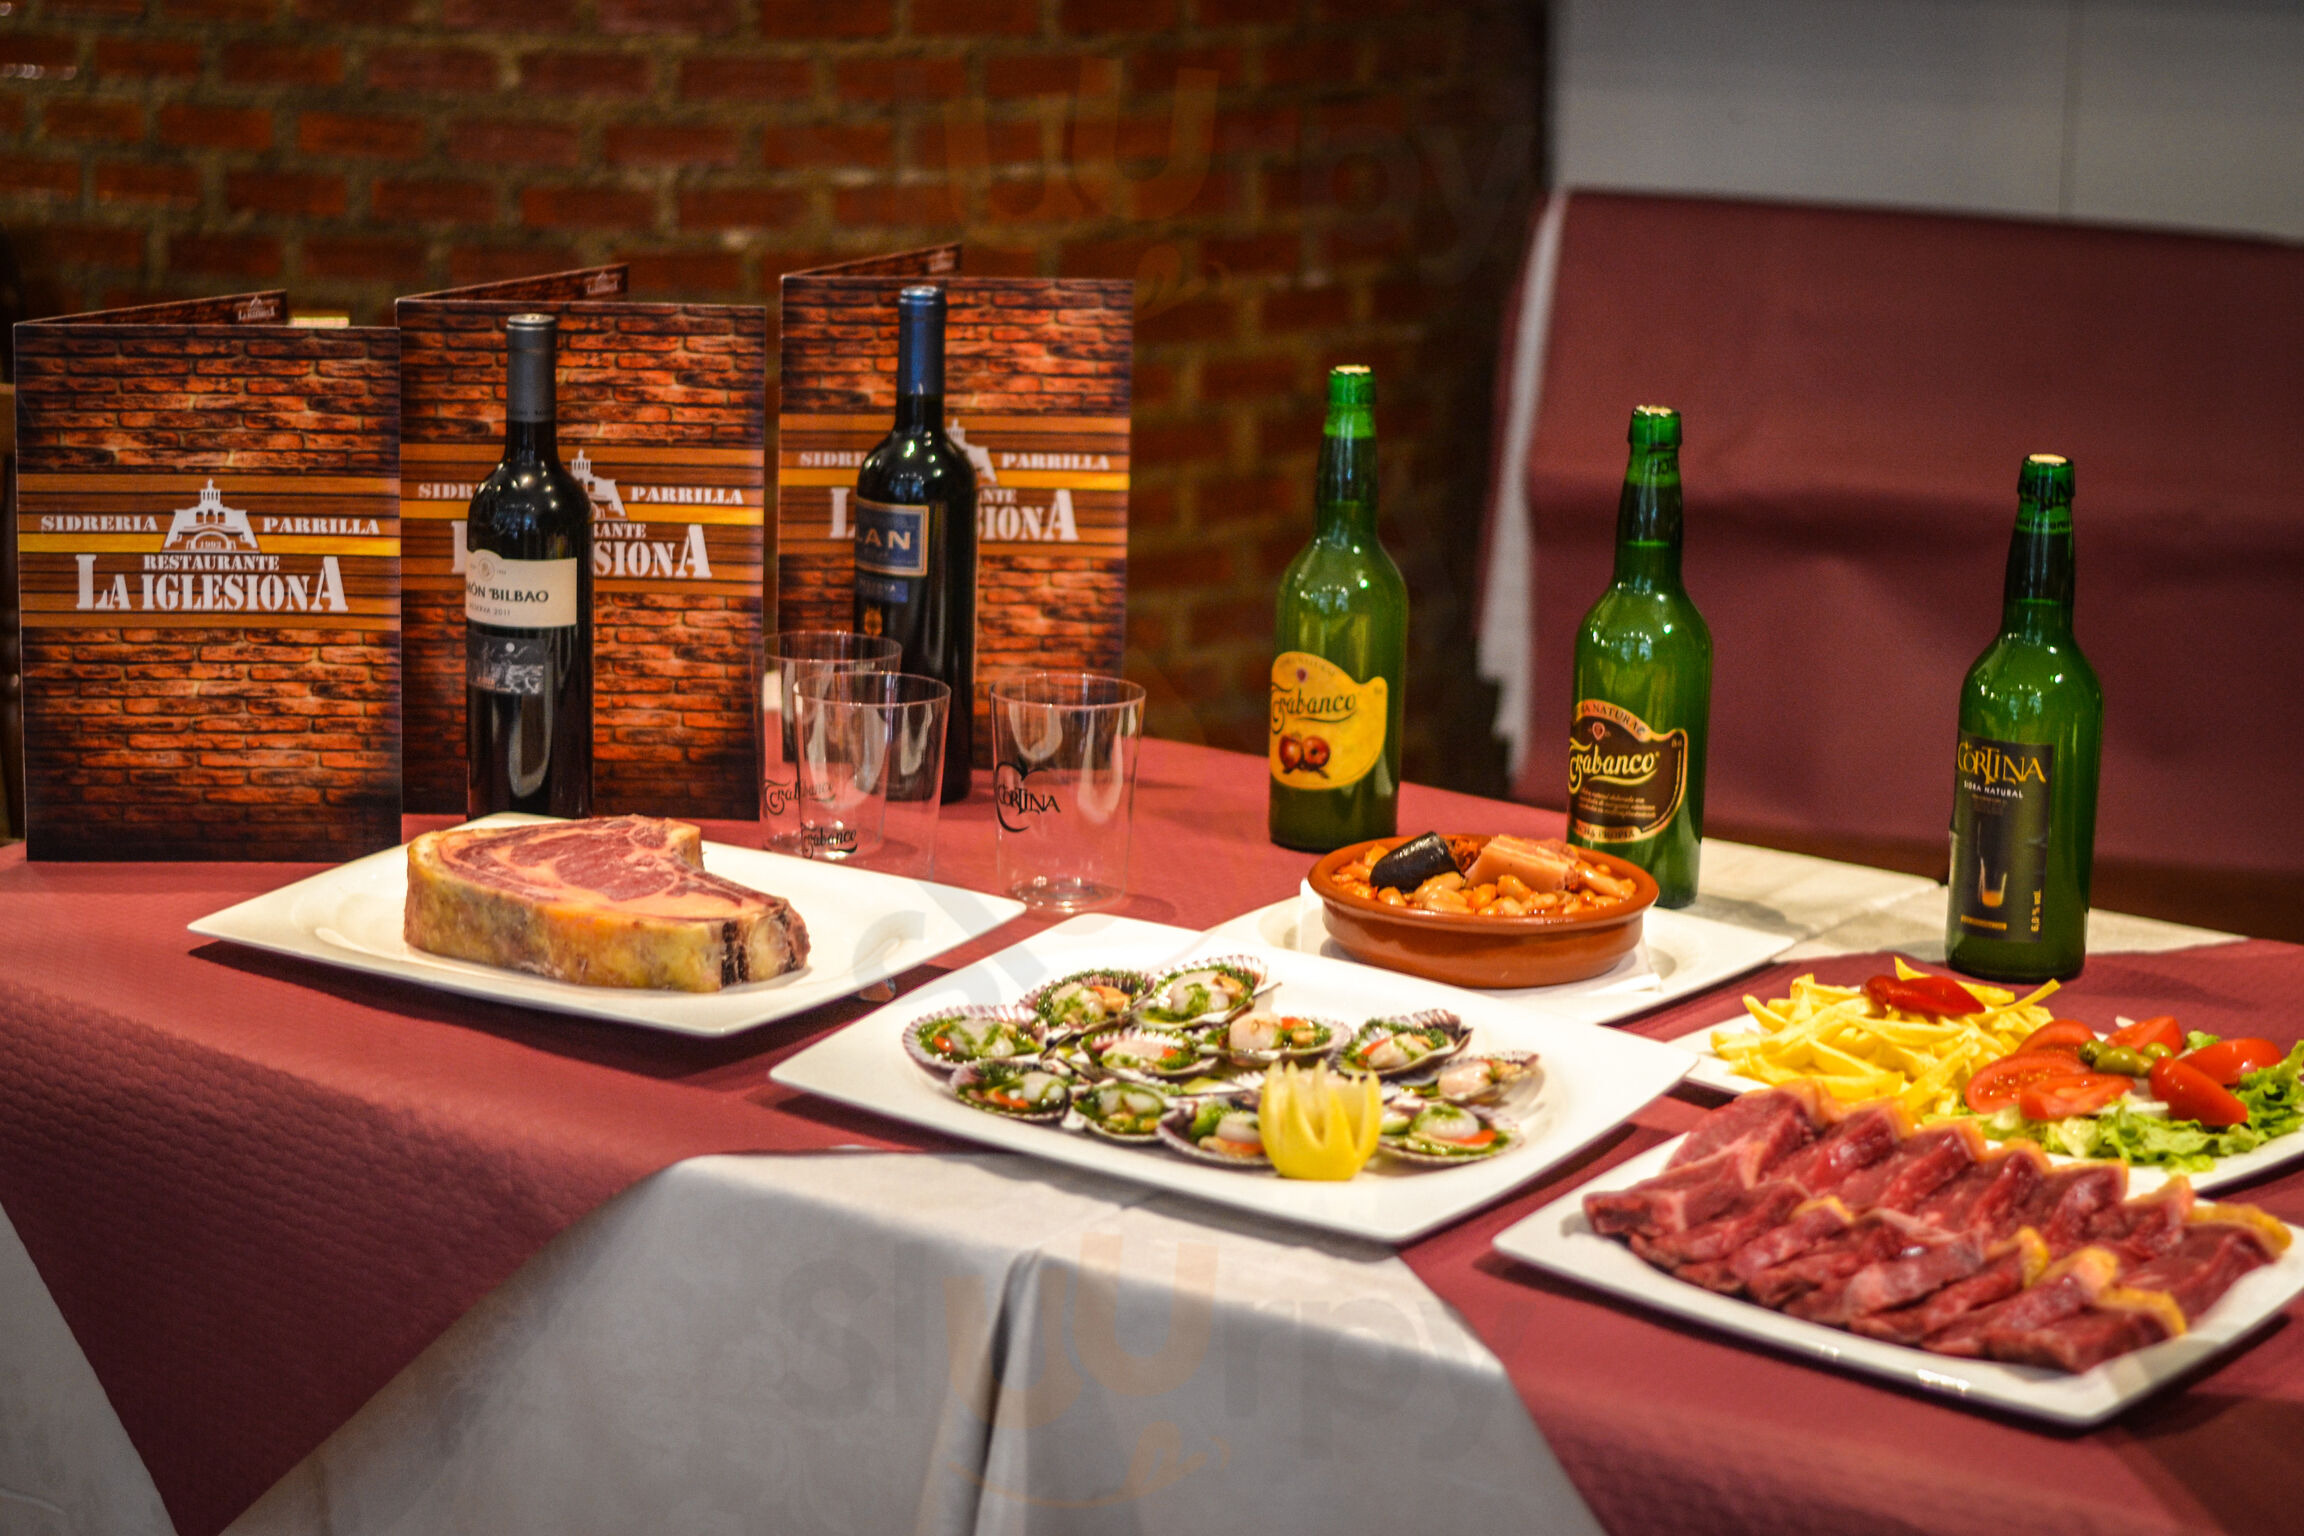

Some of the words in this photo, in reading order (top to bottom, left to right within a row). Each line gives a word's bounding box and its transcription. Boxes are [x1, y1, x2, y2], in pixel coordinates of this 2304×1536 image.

[1001, 453, 1110, 471] PARRILLA
[631, 486, 744, 505] PARRILLA
[40, 515, 158, 532] SIDRERIA
[263, 516, 380, 535] PARRILLA
[144, 555, 280, 571] RESTAURANTE
[75, 554, 132, 611] LA
[141, 555, 349, 612] IGLESIONA
[489, 587, 549, 603] BILBAO
[1568, 737, 1657, 795] Trabanco
[1958, 741, 2047, 785] CORTINA
[1984, 786, 2024, 799] NATURAL
